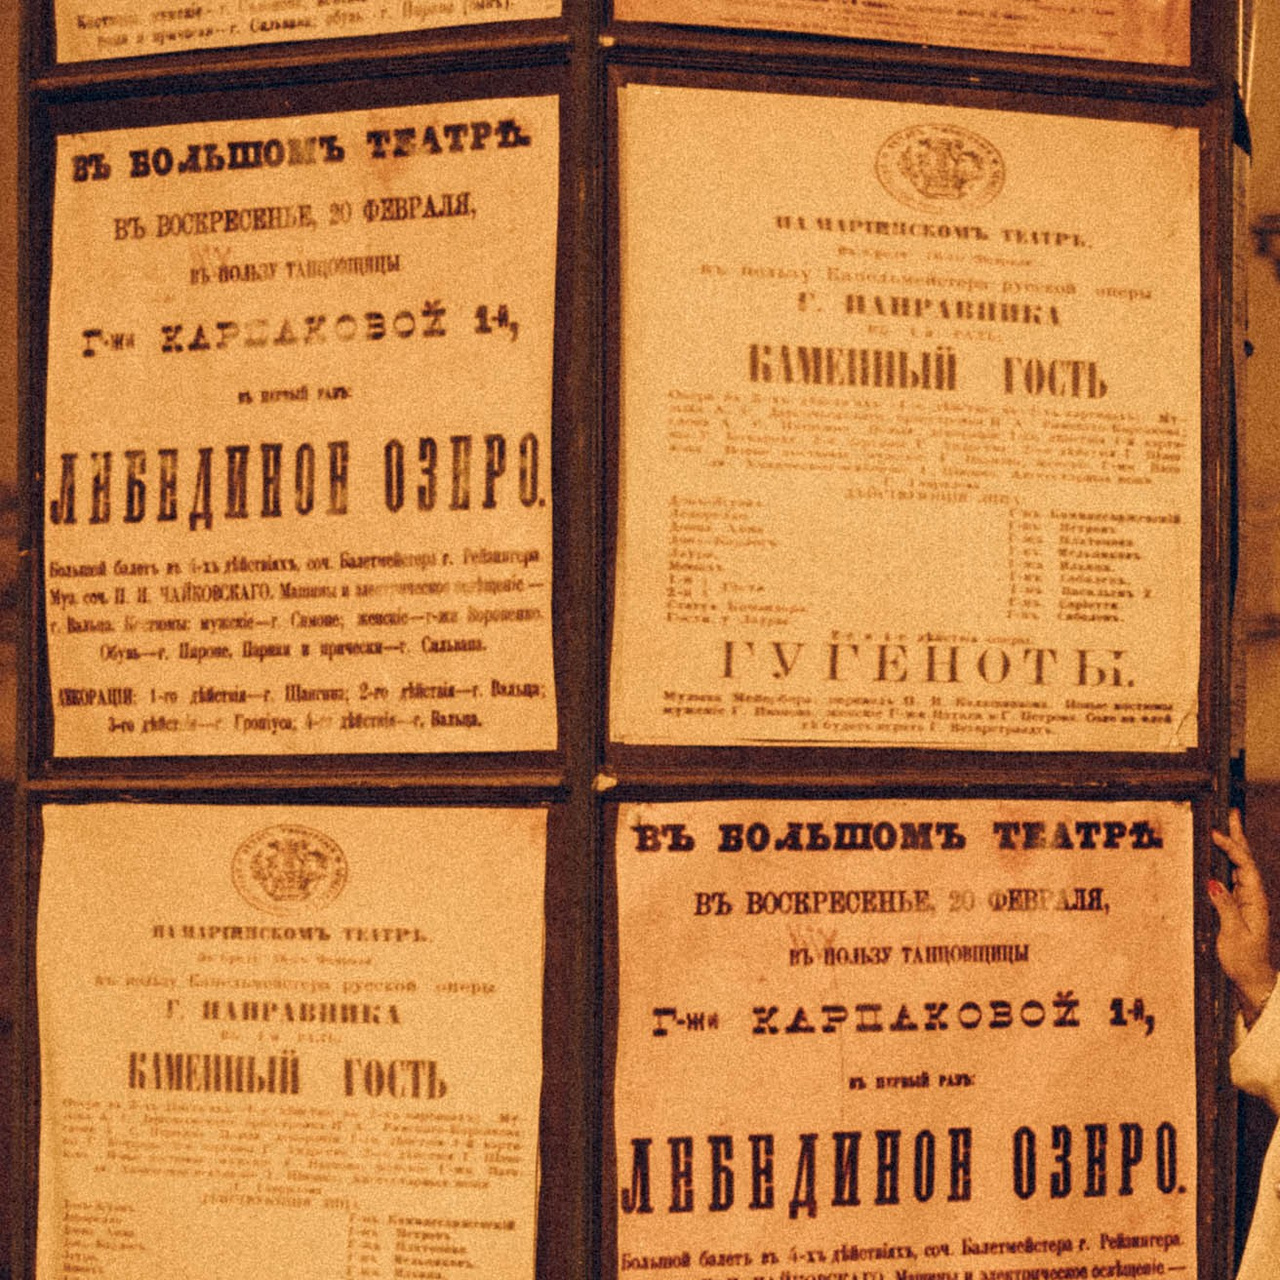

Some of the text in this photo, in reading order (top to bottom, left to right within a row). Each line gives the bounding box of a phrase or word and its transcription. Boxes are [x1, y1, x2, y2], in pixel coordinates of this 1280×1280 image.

[71, 152, 112, 183] ВЪ
[129, 134, 346, 179] БОЛЬШОМЪ
[113, 217, 147, 241] ВЪ
[748, 341, 1109, 401] КАМЕННЫЙ ГОСТЬ
[49, 431, 547, 531] ЛЕБЕДИНОЕ ОЗЕРО.
[719, 640, 1137, 690] ГУГЕНОТЫ.
[631, 823, 695, 854] ВЪ
[718, 821, 967, 854] БОЛЬШОМЪ
[694, 891, 733, 917] ВЪ
[949, 890, 977, 913] 20
[987, 888, 1111, 916] ФЕВРАЛЯ,
[824, 946, 893, 966] ПОЛЬЗУ
[751, 990, 1081, 1034] КАРПАКОВОЙ
[128, 1048, 449, 1101] КАМЕННЫЙ ГОСТЬ
[620, 1126, 973, 1219] ЛЕБЕДИНОЕ
[1013, 1119, 1187, 1201] ОЗЕРО.
[621, 1251, 690, 1271] Большой
